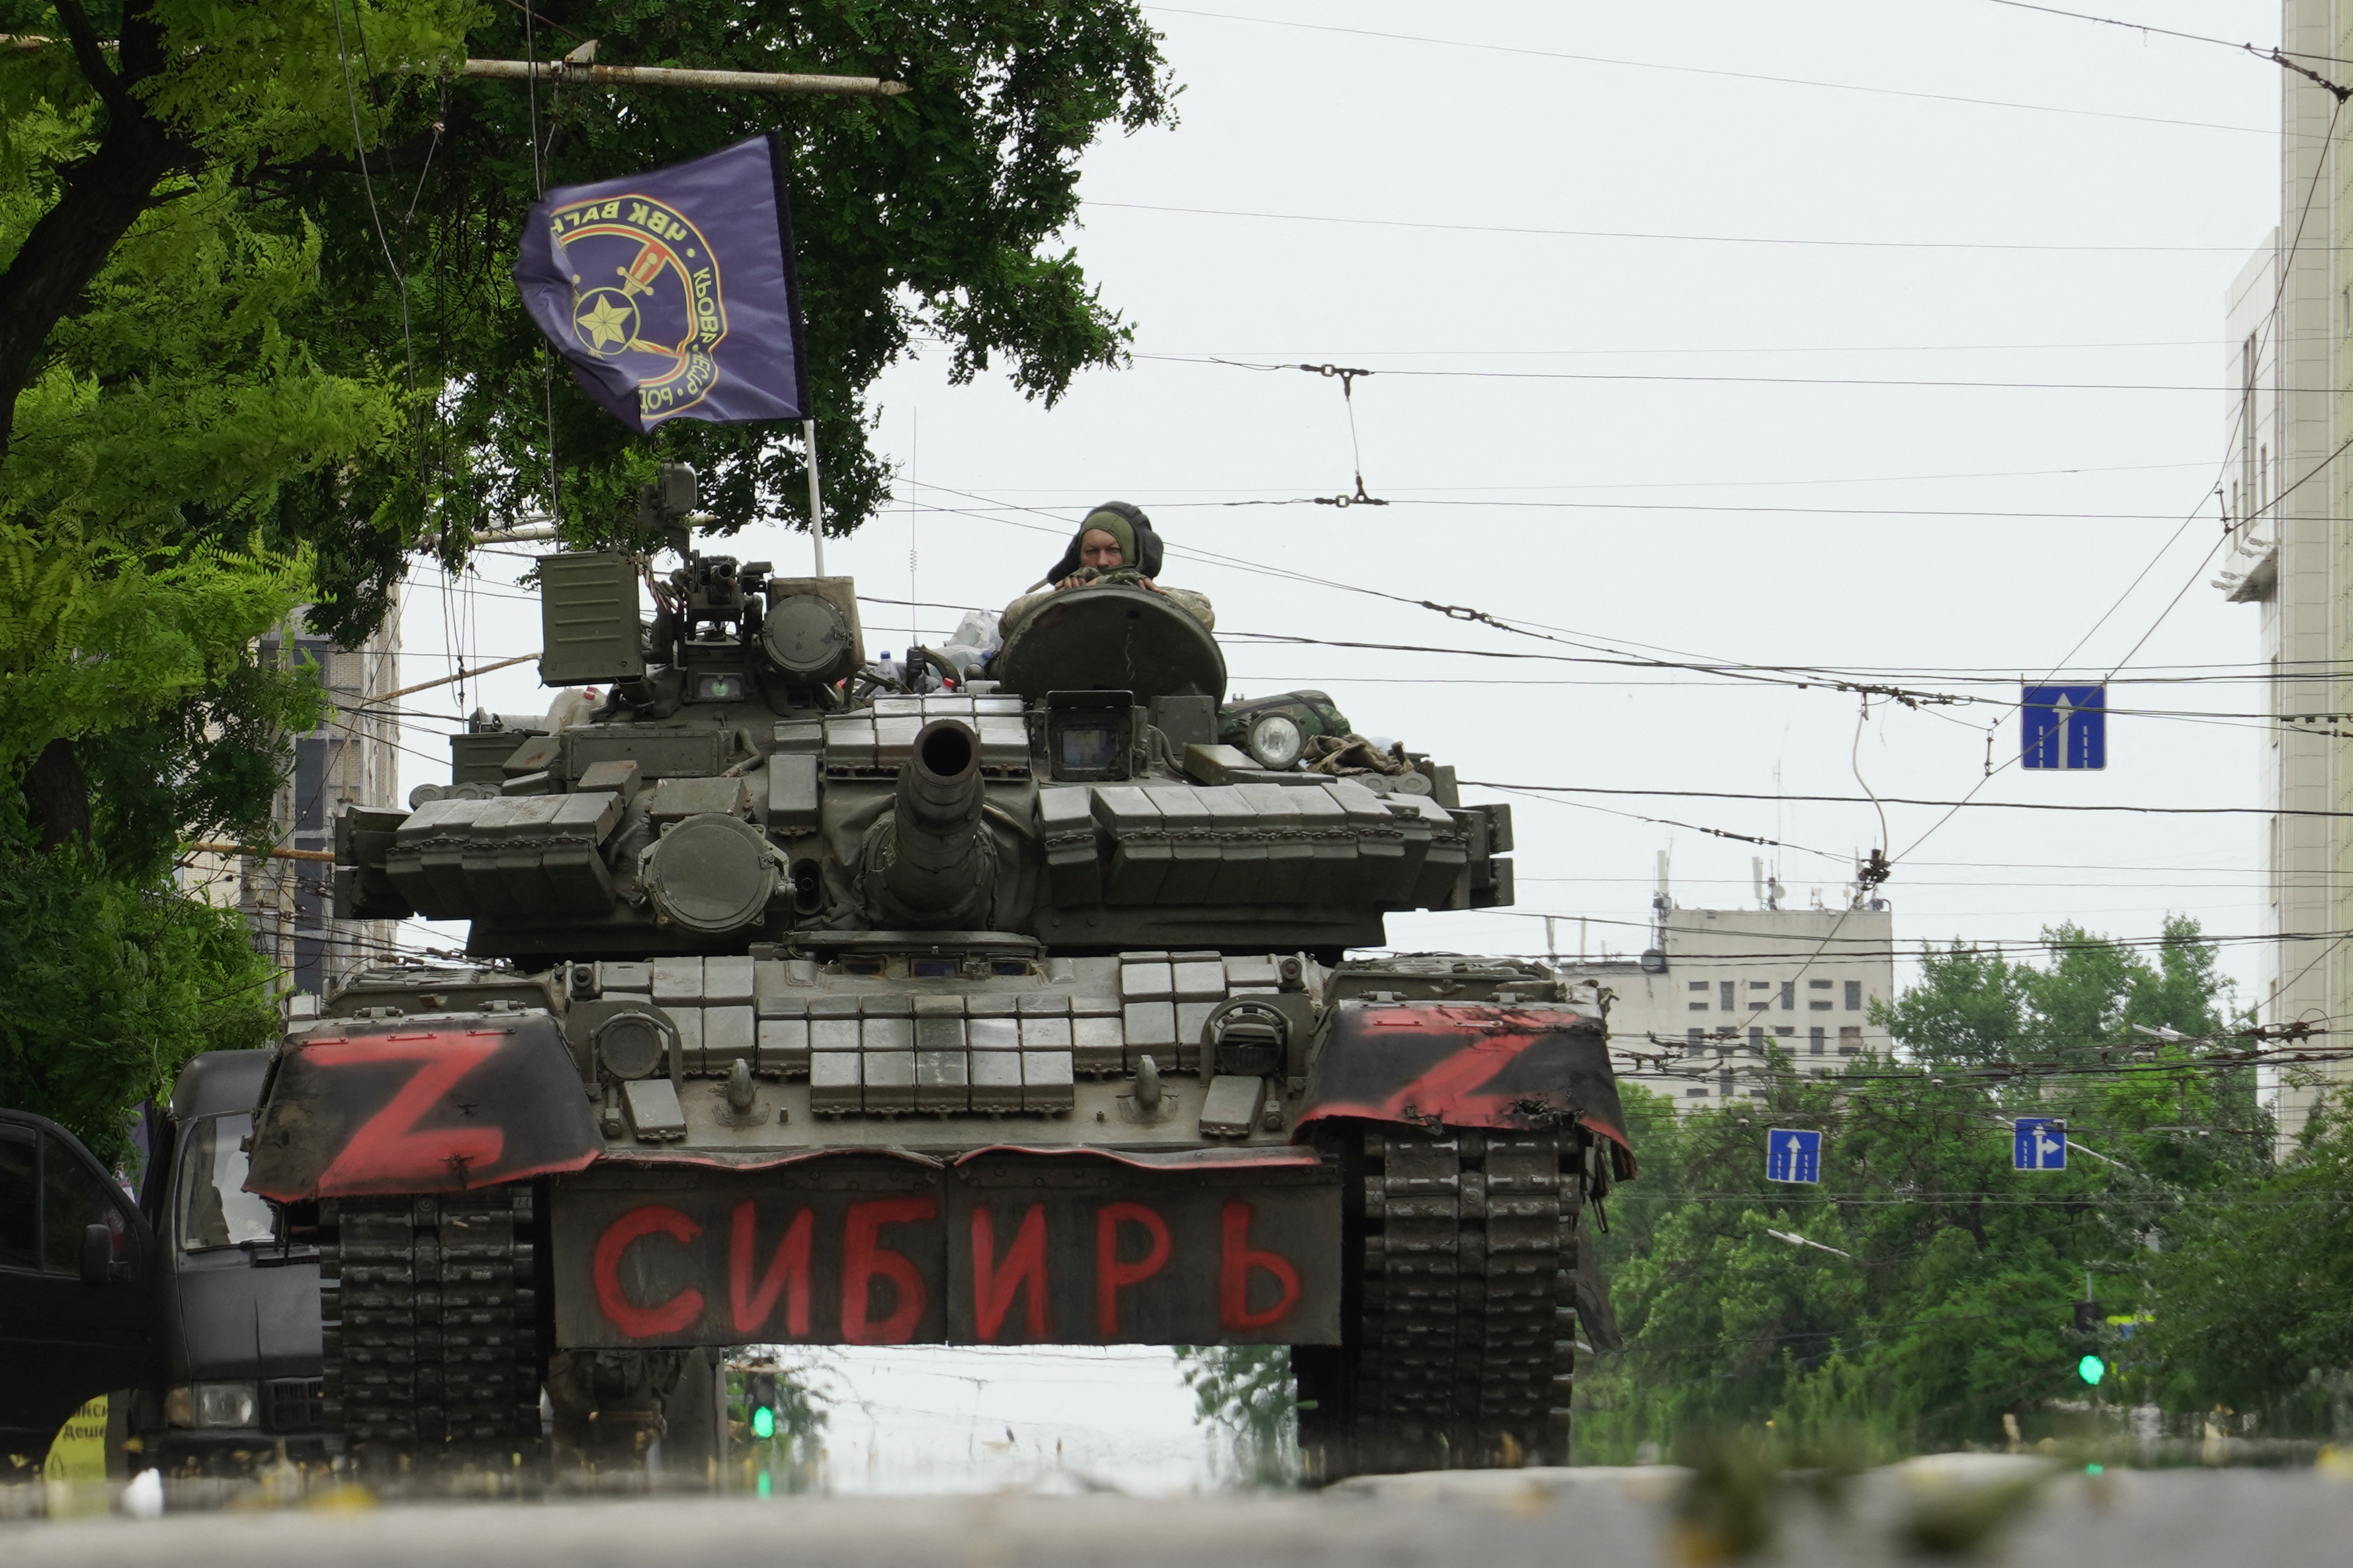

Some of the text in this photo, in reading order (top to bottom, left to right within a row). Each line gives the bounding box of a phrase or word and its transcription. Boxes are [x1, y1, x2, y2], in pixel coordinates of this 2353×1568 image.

[301, 1031, 505, 1190] Z
[1359, 1007, 1579, 1128] Z
[592, 1198, 1301, 1342] СИБИРЬ
